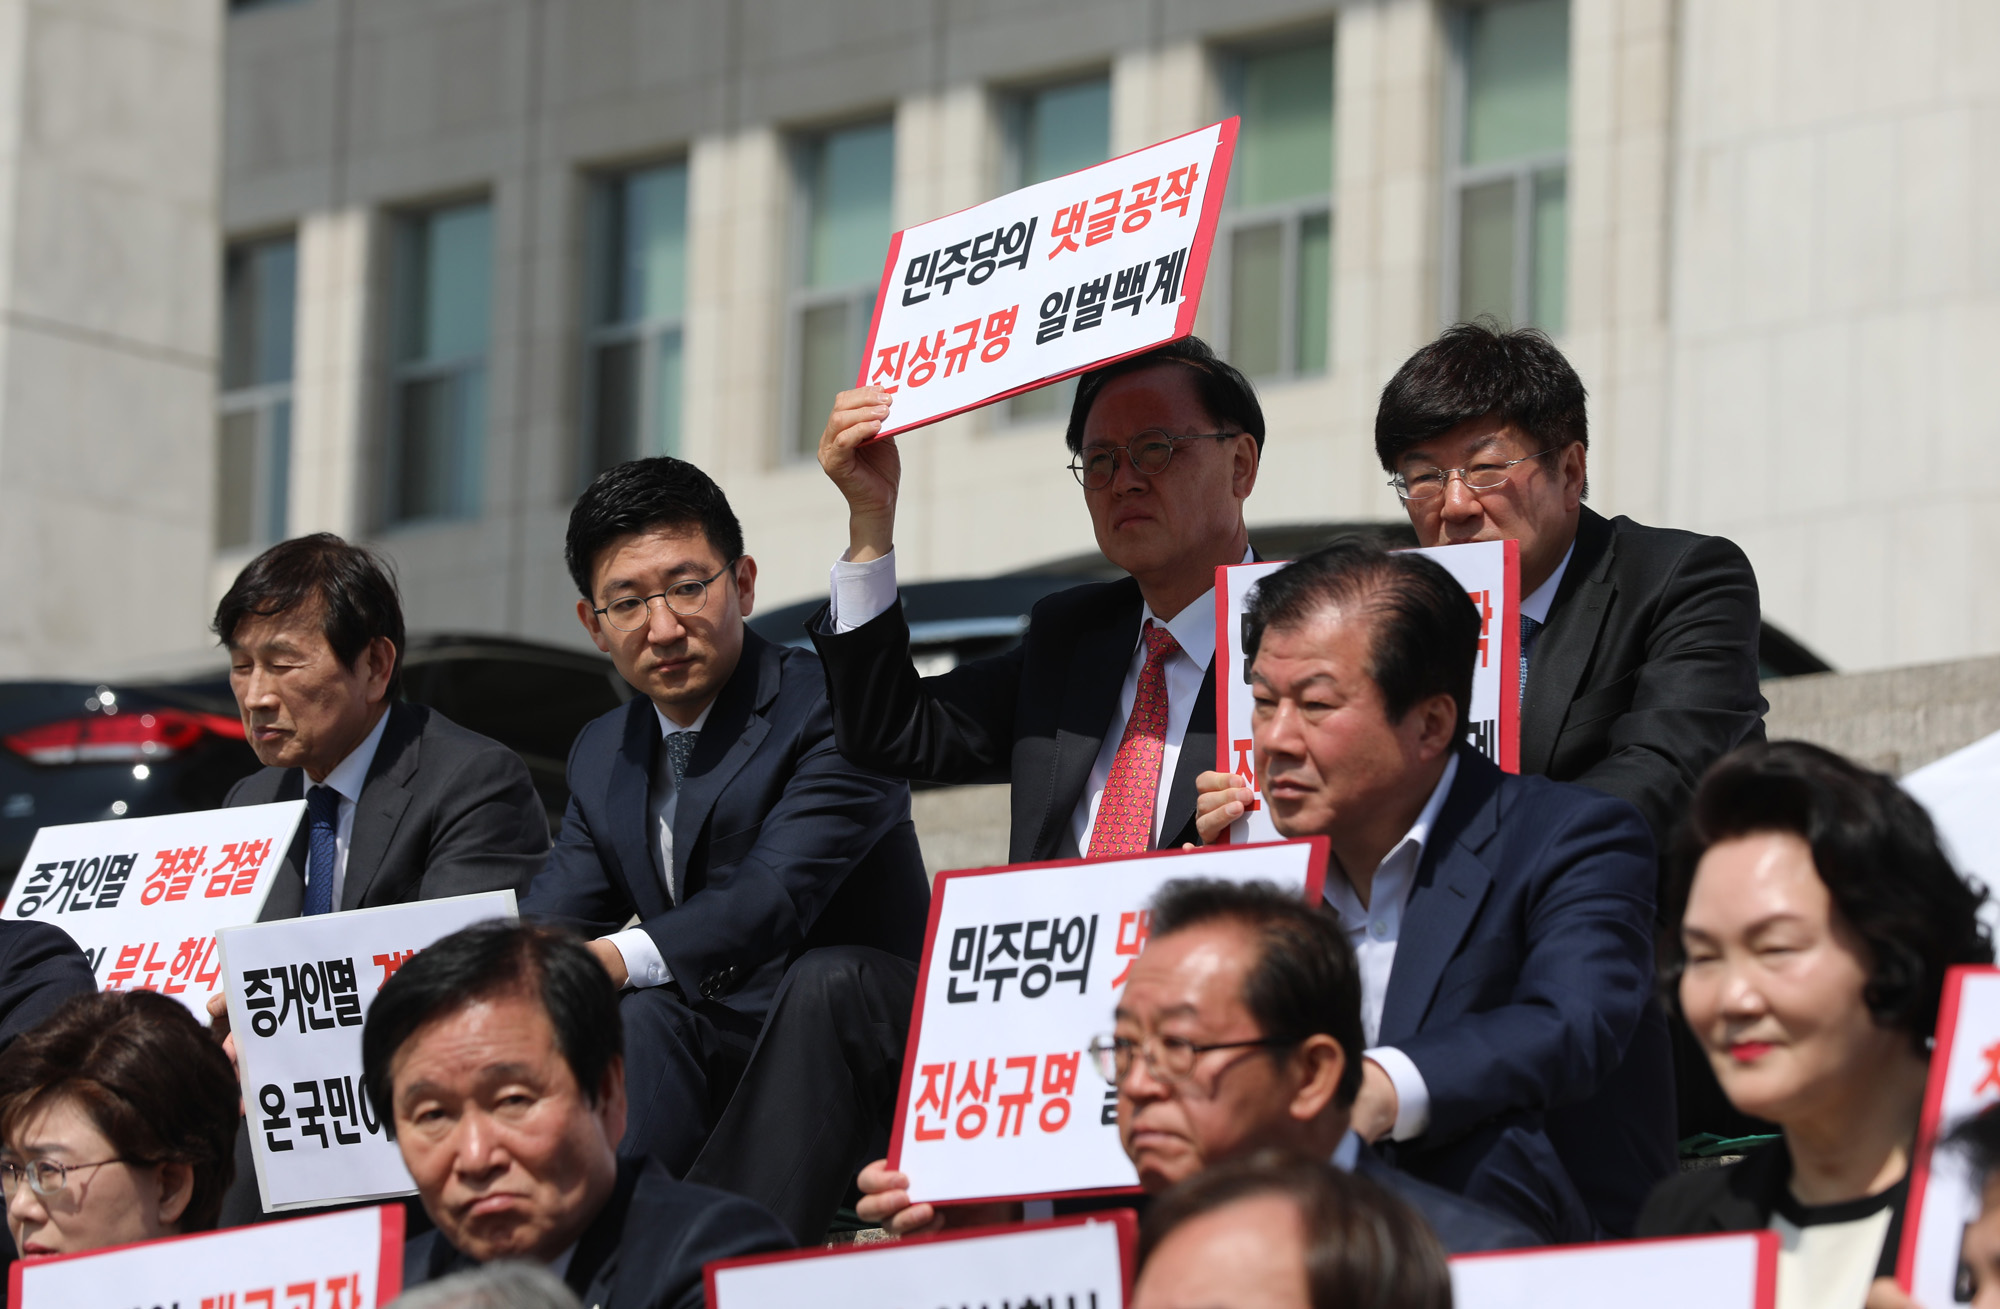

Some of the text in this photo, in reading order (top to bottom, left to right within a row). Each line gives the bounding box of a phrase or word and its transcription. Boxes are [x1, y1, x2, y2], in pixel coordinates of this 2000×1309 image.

[901, 162, 1199, 307] 민주당의 댓글공작
[871, 246, 1187, 395] 진상규명 일벌백계
[16, 852, 138, 918] 증거인멸
[242, 956, 364, 1038] 증거인멸
[946, 913, 1099, 1004] 민주당의
[914, 1051, 1081, 1142] 진상규명
